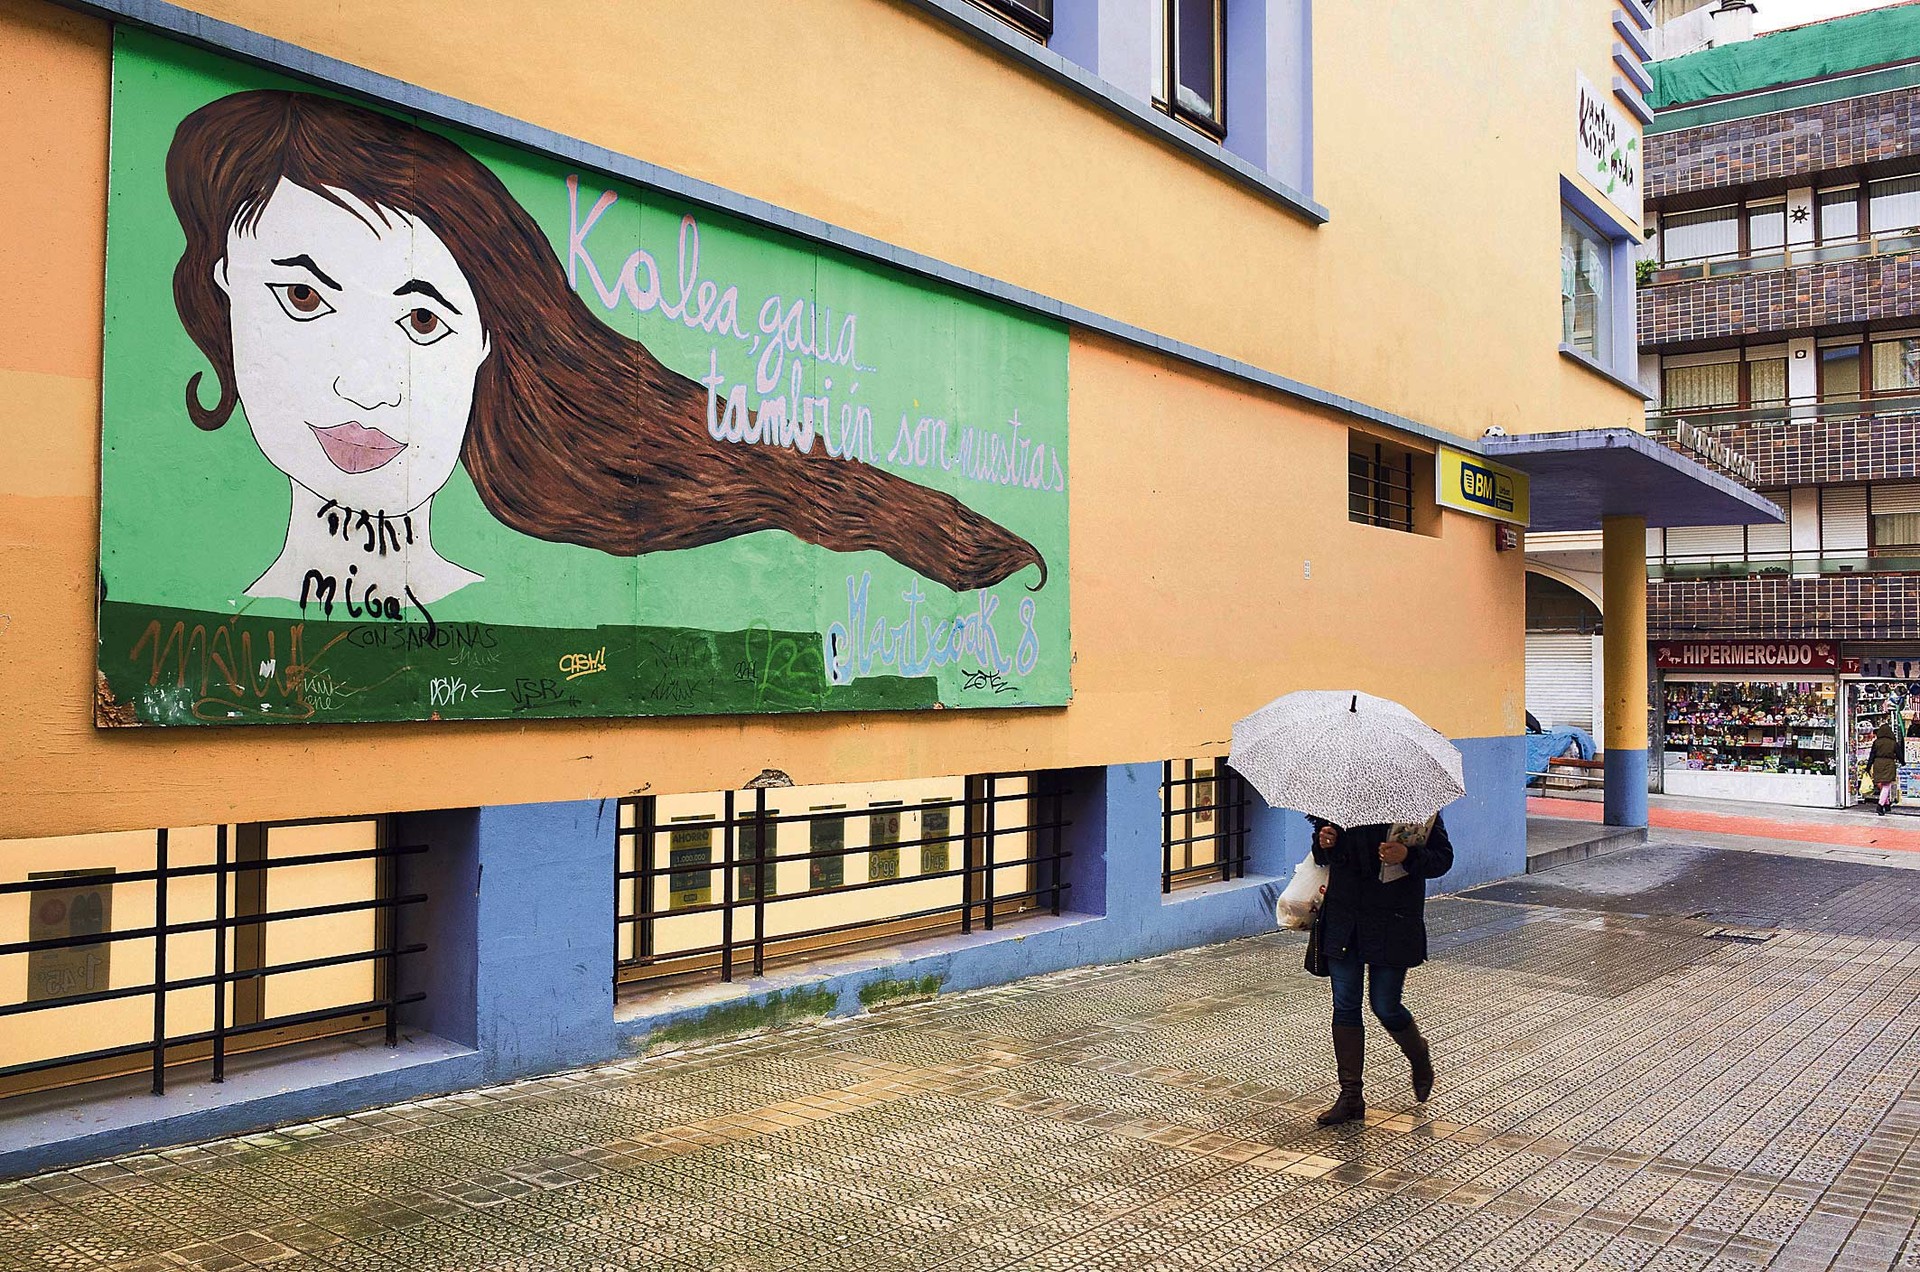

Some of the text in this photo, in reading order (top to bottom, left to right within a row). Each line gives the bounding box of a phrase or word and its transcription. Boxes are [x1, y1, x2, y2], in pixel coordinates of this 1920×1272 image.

[701, 349, 1064, 492] también son nuestras
[1475, 472, 1493, 500] BM
[1015, 596, 1039, 676] 8
[1683, 644, 1812, 665] HIPERMERCADO
